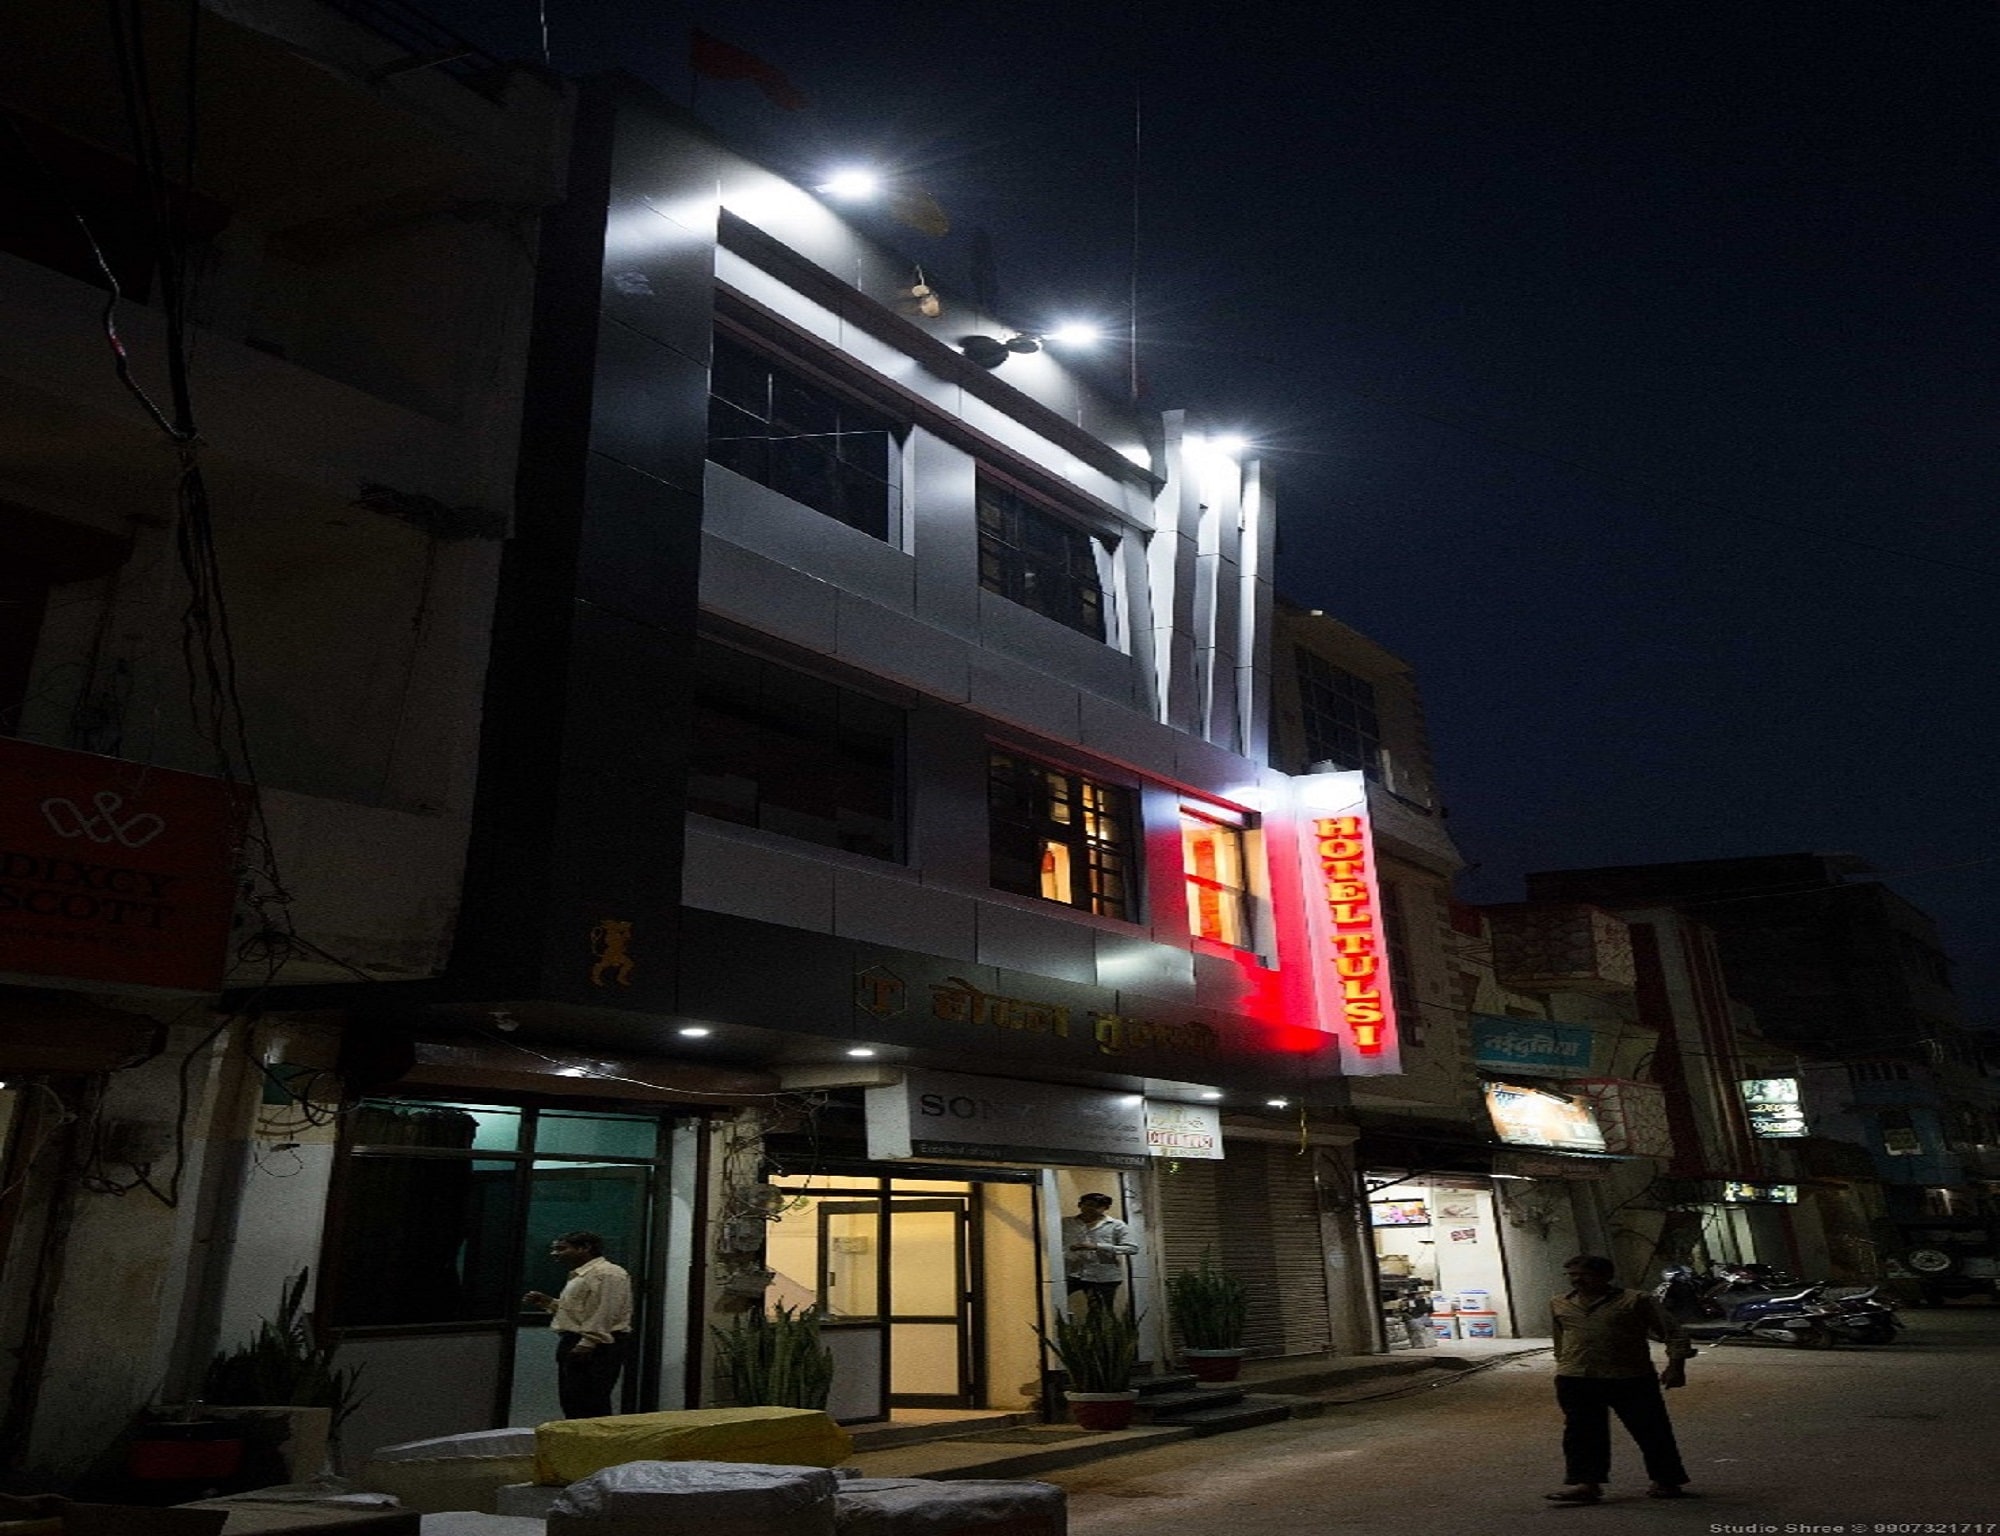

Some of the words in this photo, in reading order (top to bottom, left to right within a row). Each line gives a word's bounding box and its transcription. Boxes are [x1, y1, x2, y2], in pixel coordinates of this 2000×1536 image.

[0, 851, 179, 898] DIXCY
[0, 882, 176, 928] SCOTT
[1313, 816, 1372, 927] HOTEL
[1331, 933, 1386, 1054] TULSI
